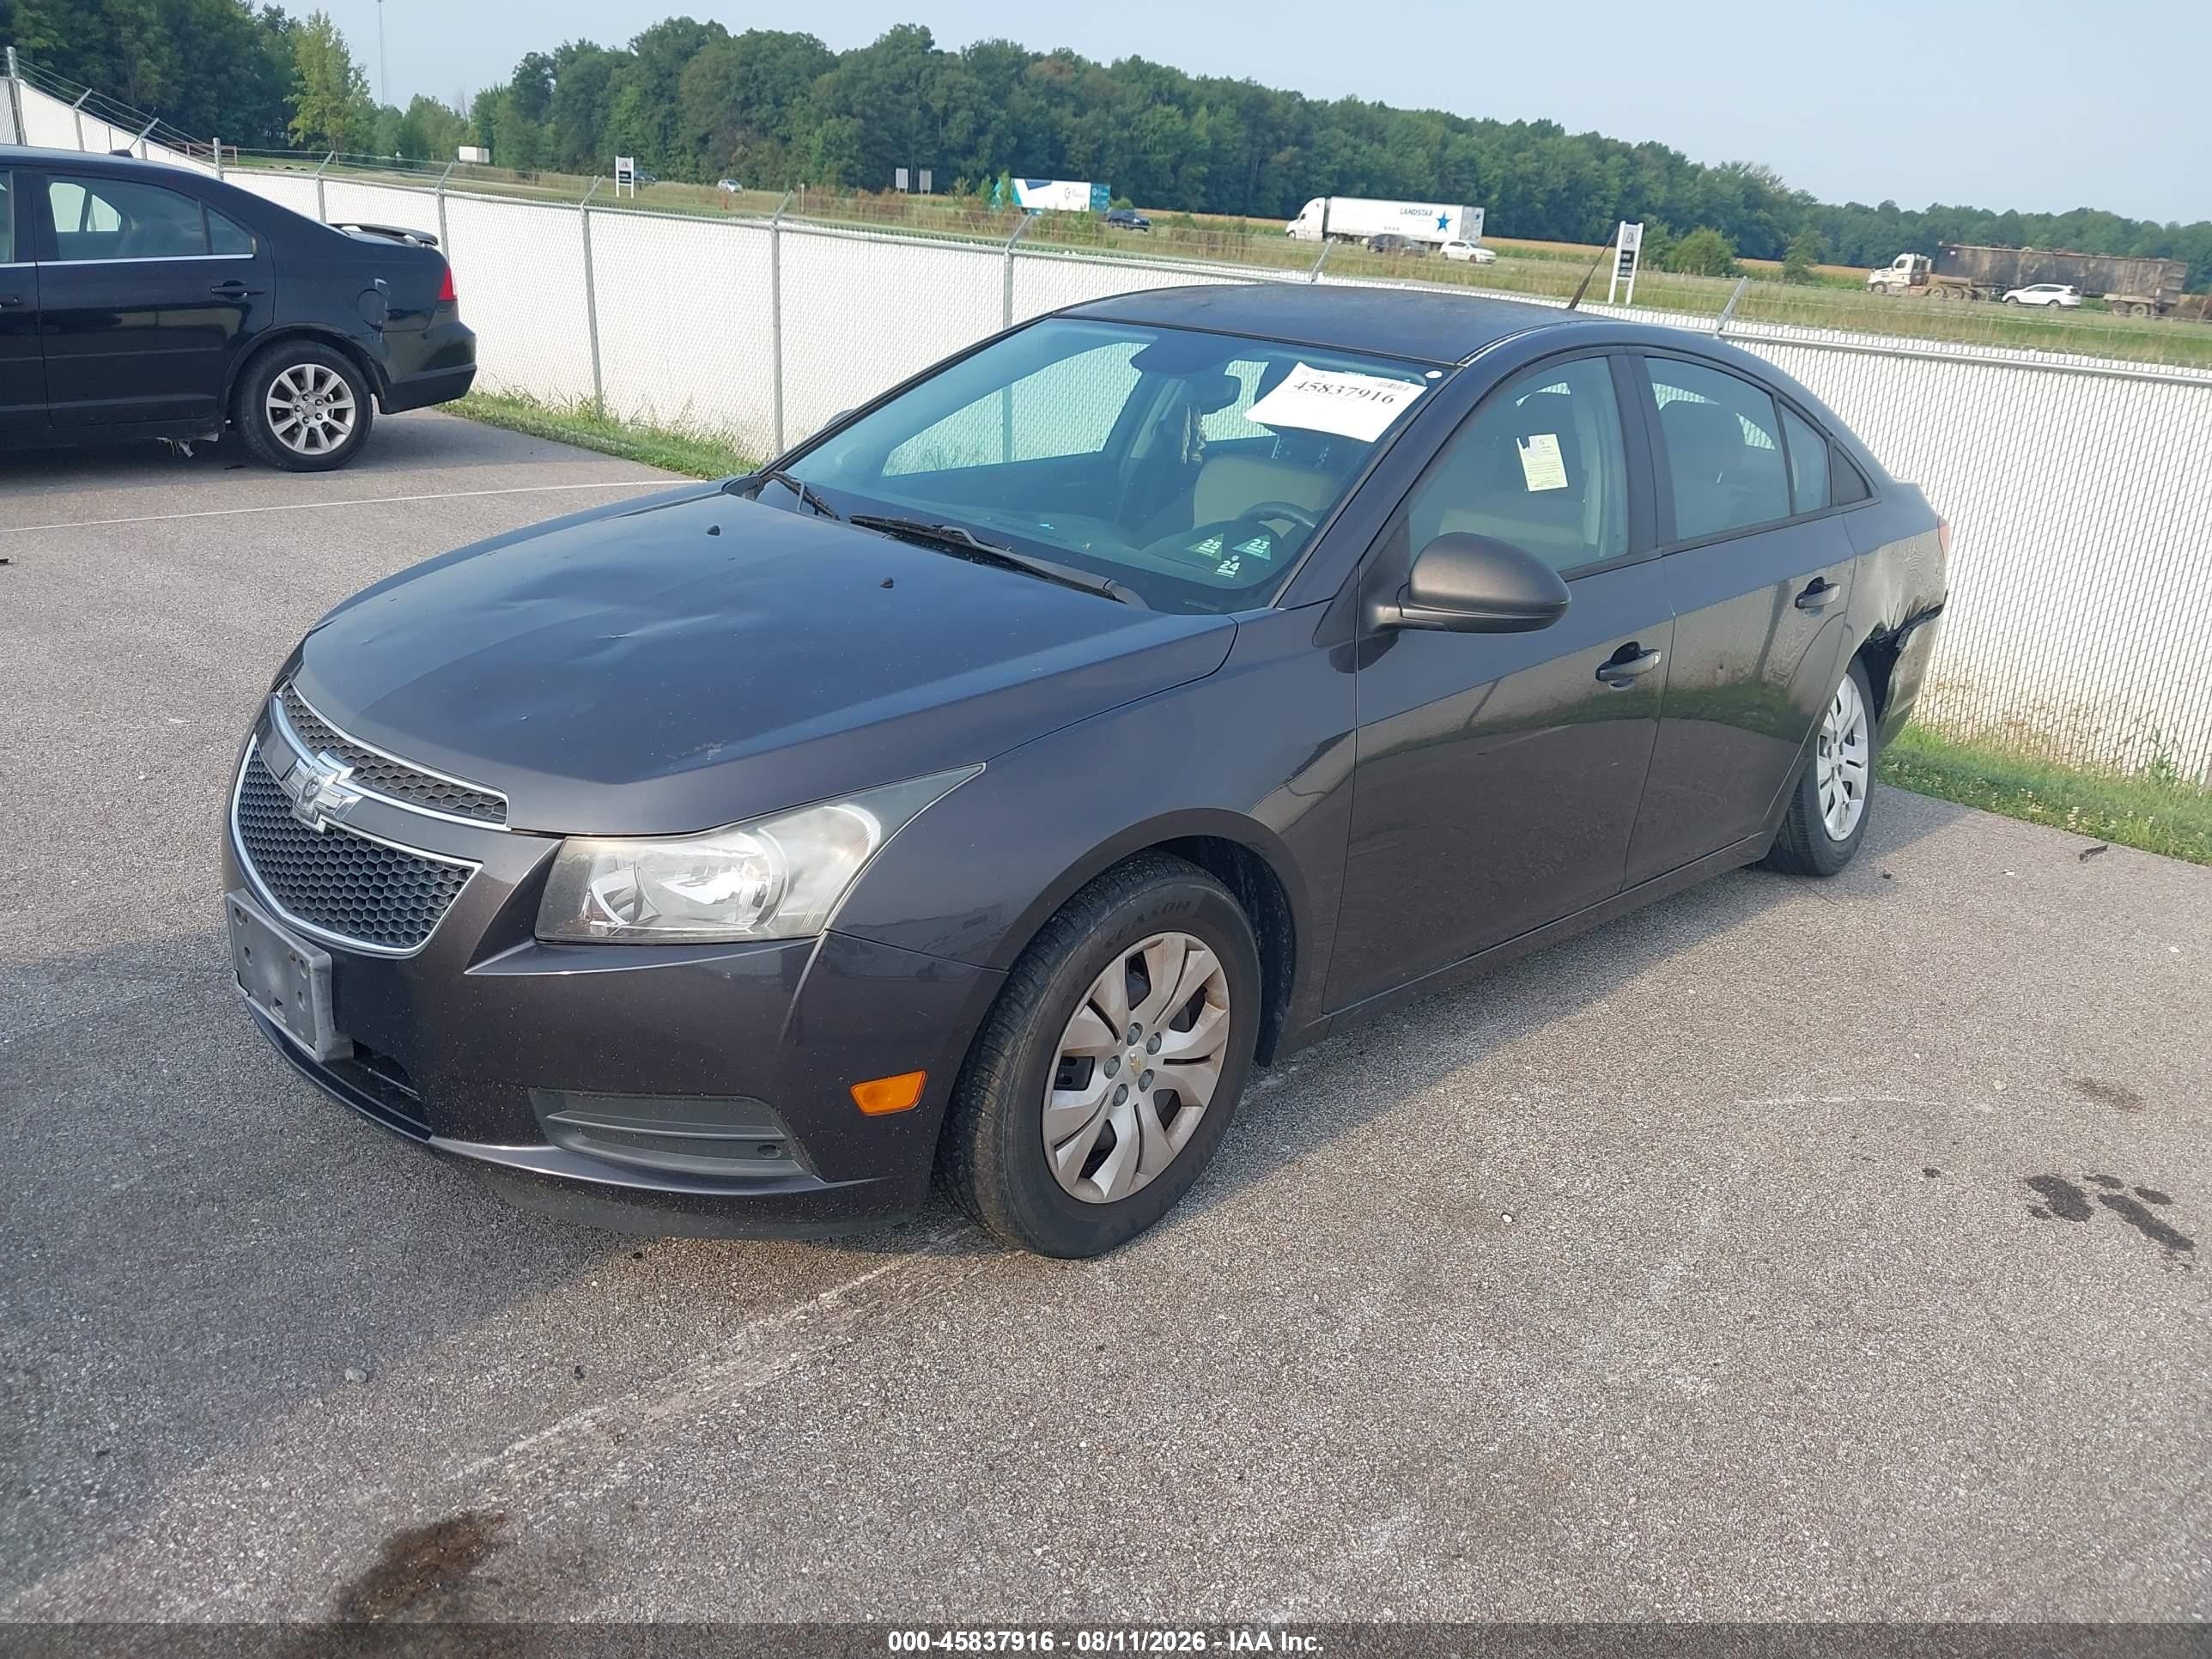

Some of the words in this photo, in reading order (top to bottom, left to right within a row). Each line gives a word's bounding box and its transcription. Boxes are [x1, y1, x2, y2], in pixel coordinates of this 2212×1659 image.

[1400, 208, 1434, 217] LANDSTAR
[1293, 380, 1396, 404] 45837916
[1202, 538, 1223, 550] 25
[1249, 538, 1270, 550] 23
[1219, 560, 1241, 571] 24
